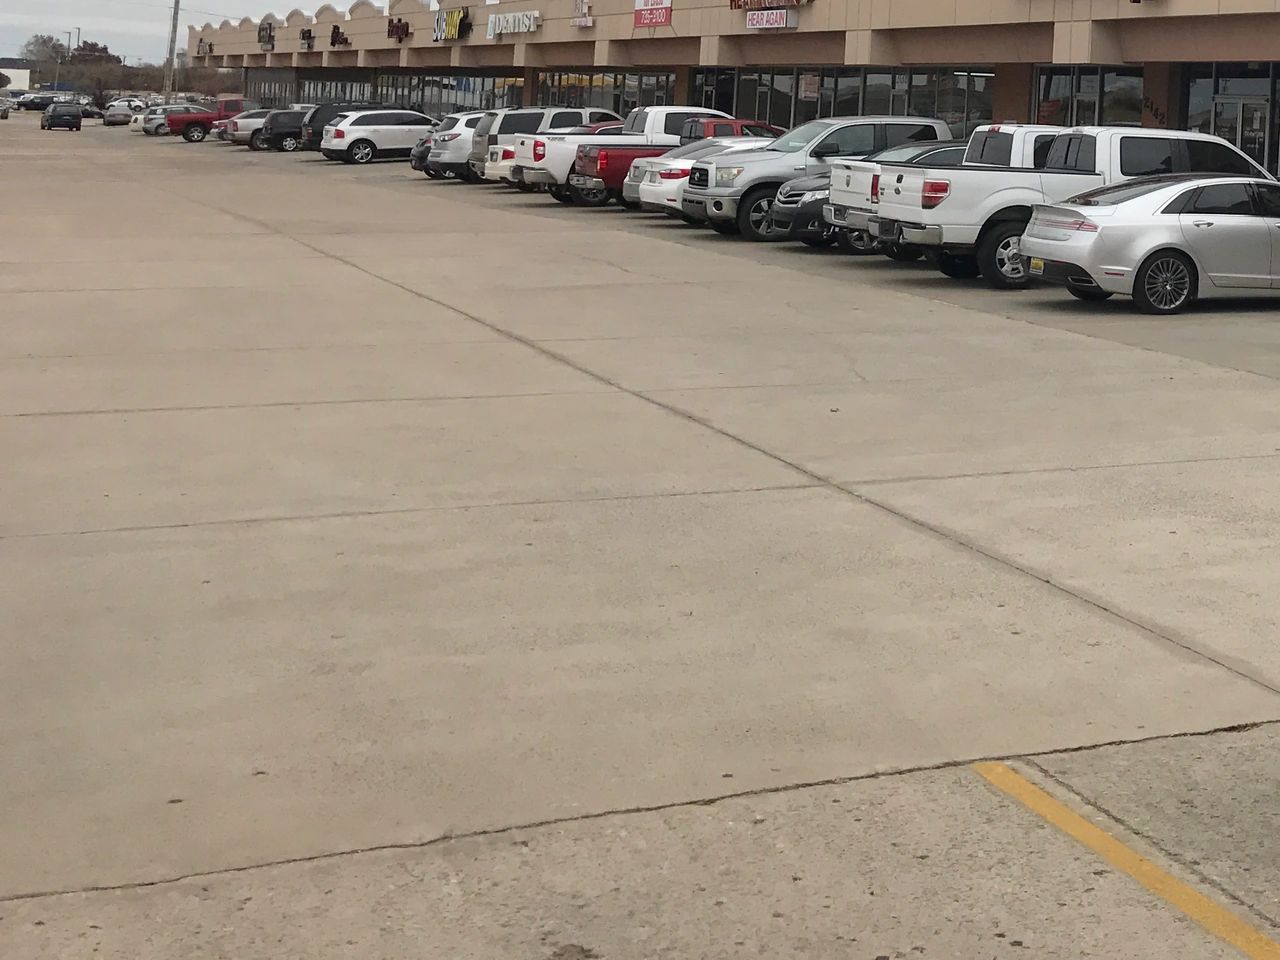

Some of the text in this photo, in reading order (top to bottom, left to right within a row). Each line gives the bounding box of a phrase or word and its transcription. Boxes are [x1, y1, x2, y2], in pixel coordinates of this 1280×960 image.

[495, 10, 540, 34] DENTIST
[747, 11, 785, 27] HEAR AGAIN
